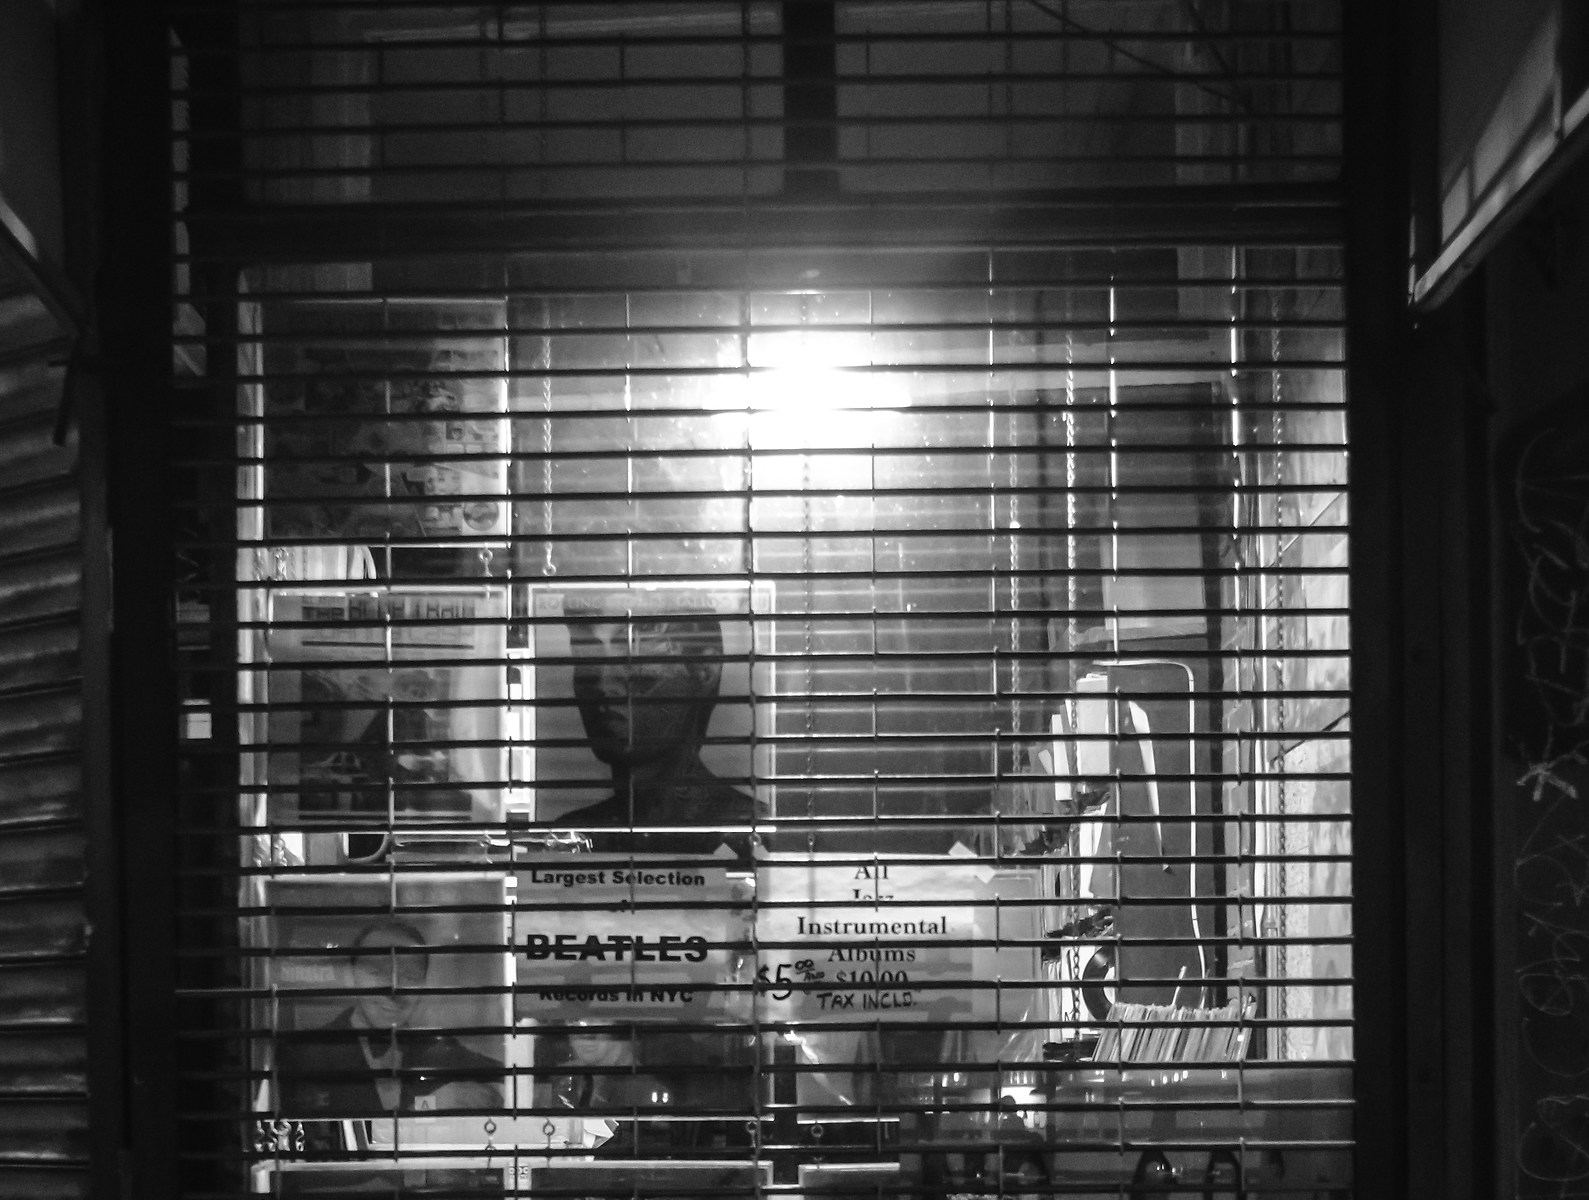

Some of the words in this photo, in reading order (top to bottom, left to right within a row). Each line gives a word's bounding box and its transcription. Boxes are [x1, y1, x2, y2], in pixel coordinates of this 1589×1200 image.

[532, 869, 605, 887] Largest
[612, 871, 705, 886] Selection
[854, 866, 889, 880] All
[797, 916, 947, 935] Instrumental
[526, 934, 708, 963] BEATLES
[828, 949, 916, 962] Albums
[650, 989, 693, 1003] NYC
[816, 992, 855, 1010] TAX
